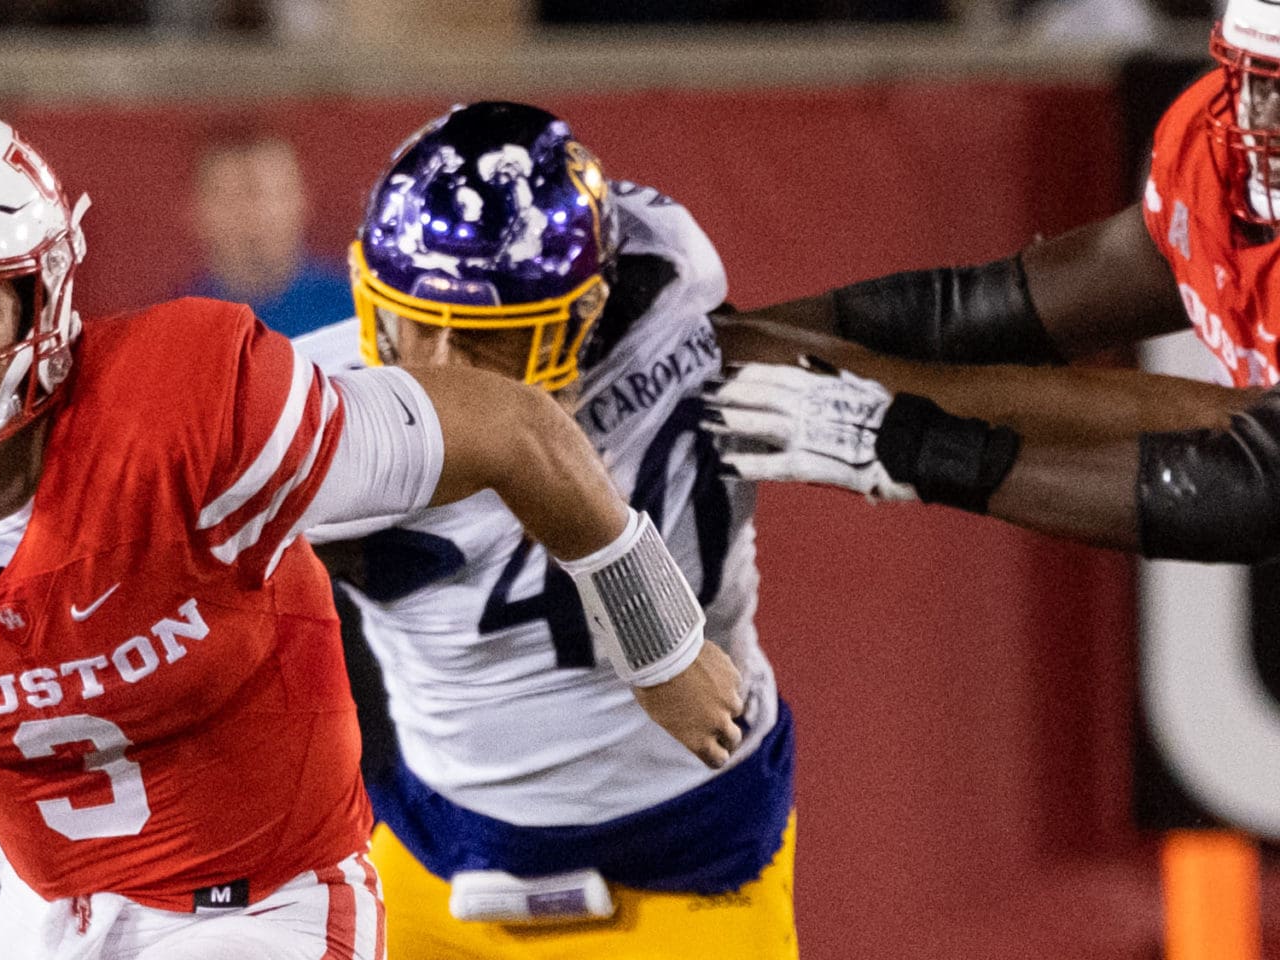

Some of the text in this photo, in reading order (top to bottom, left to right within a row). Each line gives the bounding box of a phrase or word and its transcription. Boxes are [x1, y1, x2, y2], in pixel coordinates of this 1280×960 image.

[588, 325, 717, 434] CAROLIN
[12, 714, 152, 841] 3
[211, 887, 232, 903] M
